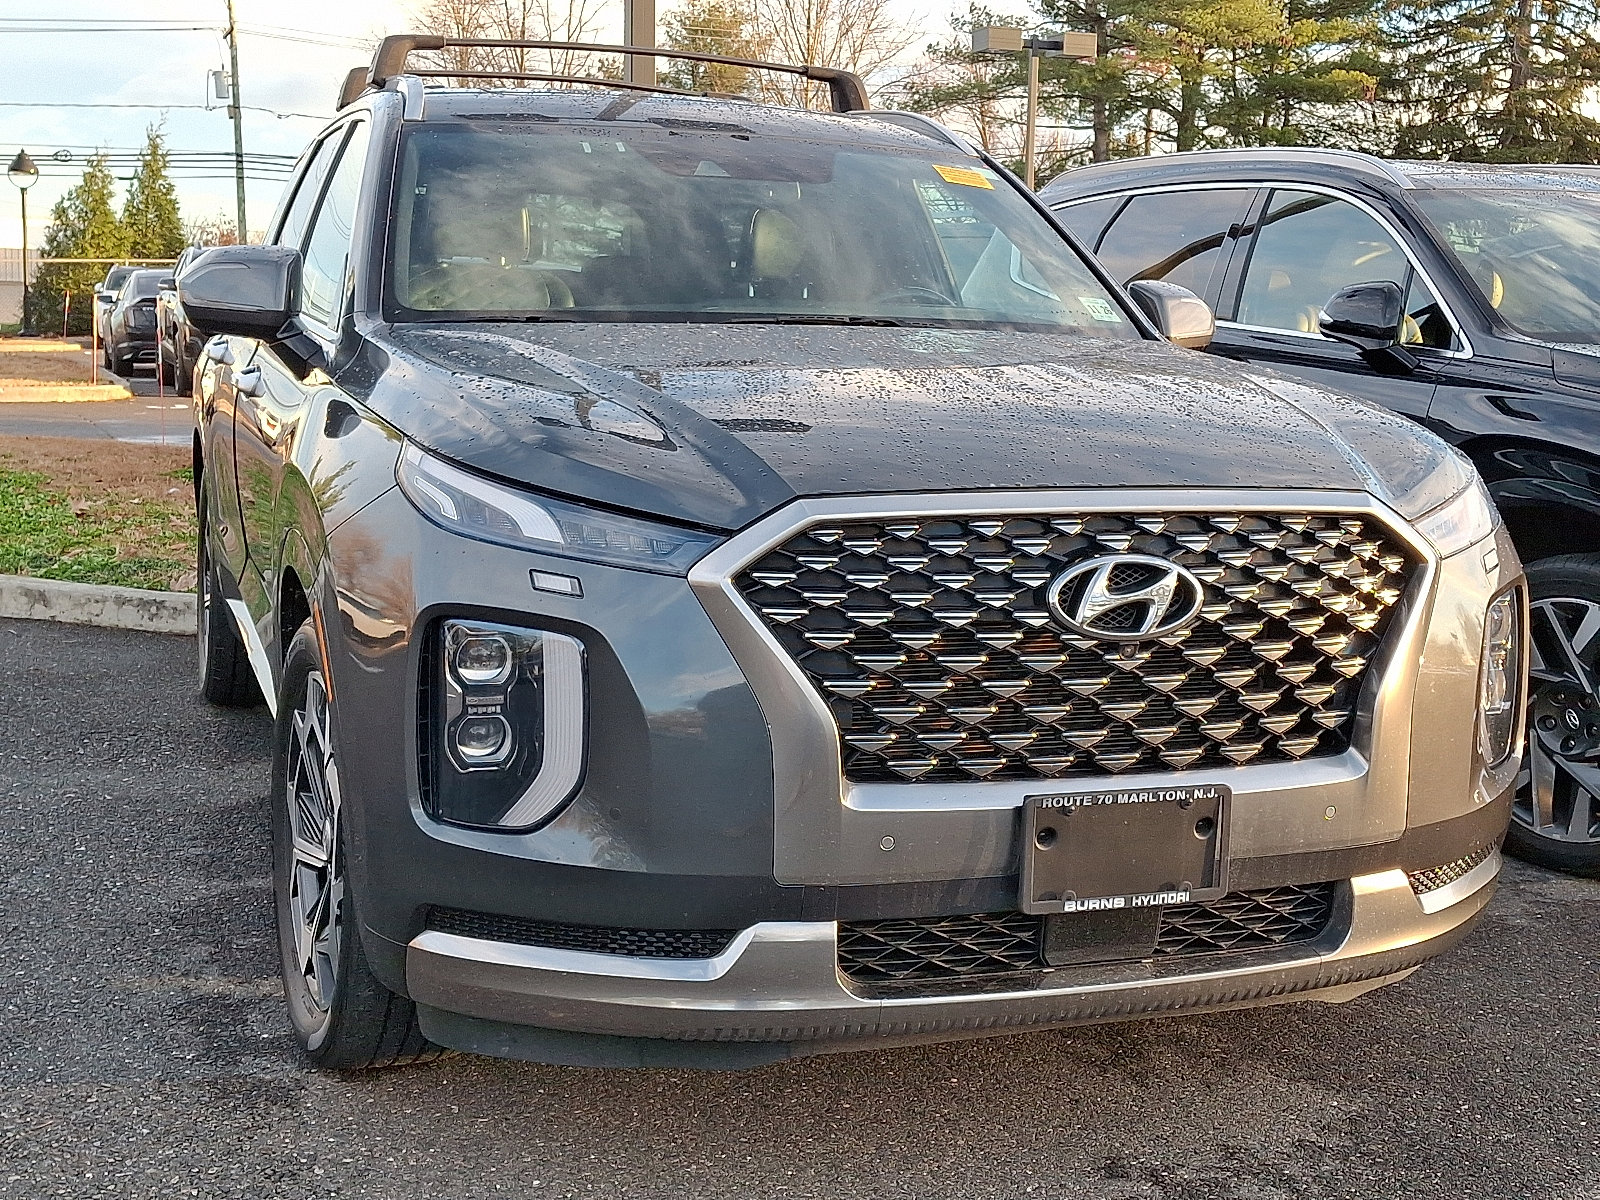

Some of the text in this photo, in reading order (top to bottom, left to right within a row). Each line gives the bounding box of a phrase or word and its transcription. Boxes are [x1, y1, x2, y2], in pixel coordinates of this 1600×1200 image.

[1041, 796, 1093, 808] ROUTE
[1096, 794, 1114, 805] 70
[1193, 787, 1219, 800] N.J.
[1063, 892, 1191, 912] BURNS HYUNDAI
